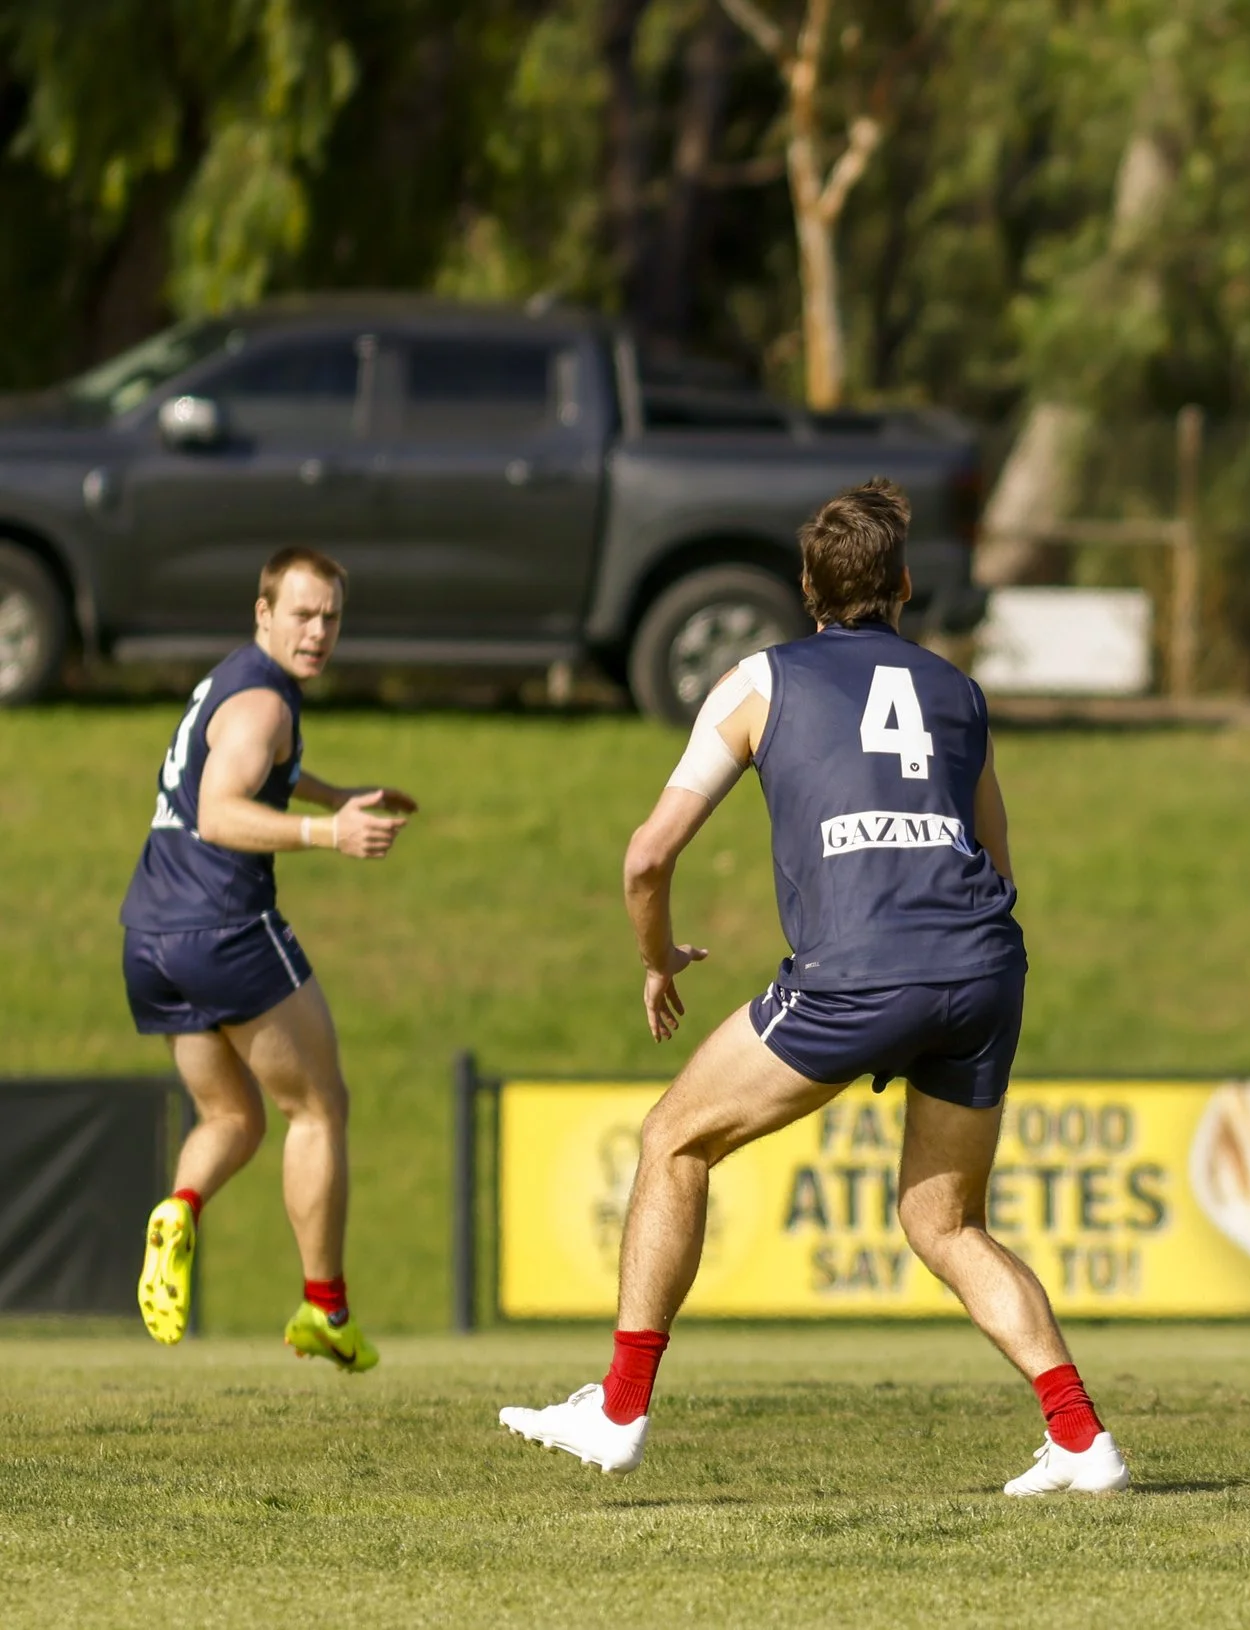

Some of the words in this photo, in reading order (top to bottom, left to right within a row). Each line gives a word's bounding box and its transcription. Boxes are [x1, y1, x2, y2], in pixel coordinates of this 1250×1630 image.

[860, 665, 934, 780] 4
[828, 816, 962, 849] GAZMA
[820, 1102, 906, 1150] FA
[1002, 1102, 1134, 1151] OOD
[784, 1163, 1168, 1231] ATHETES
